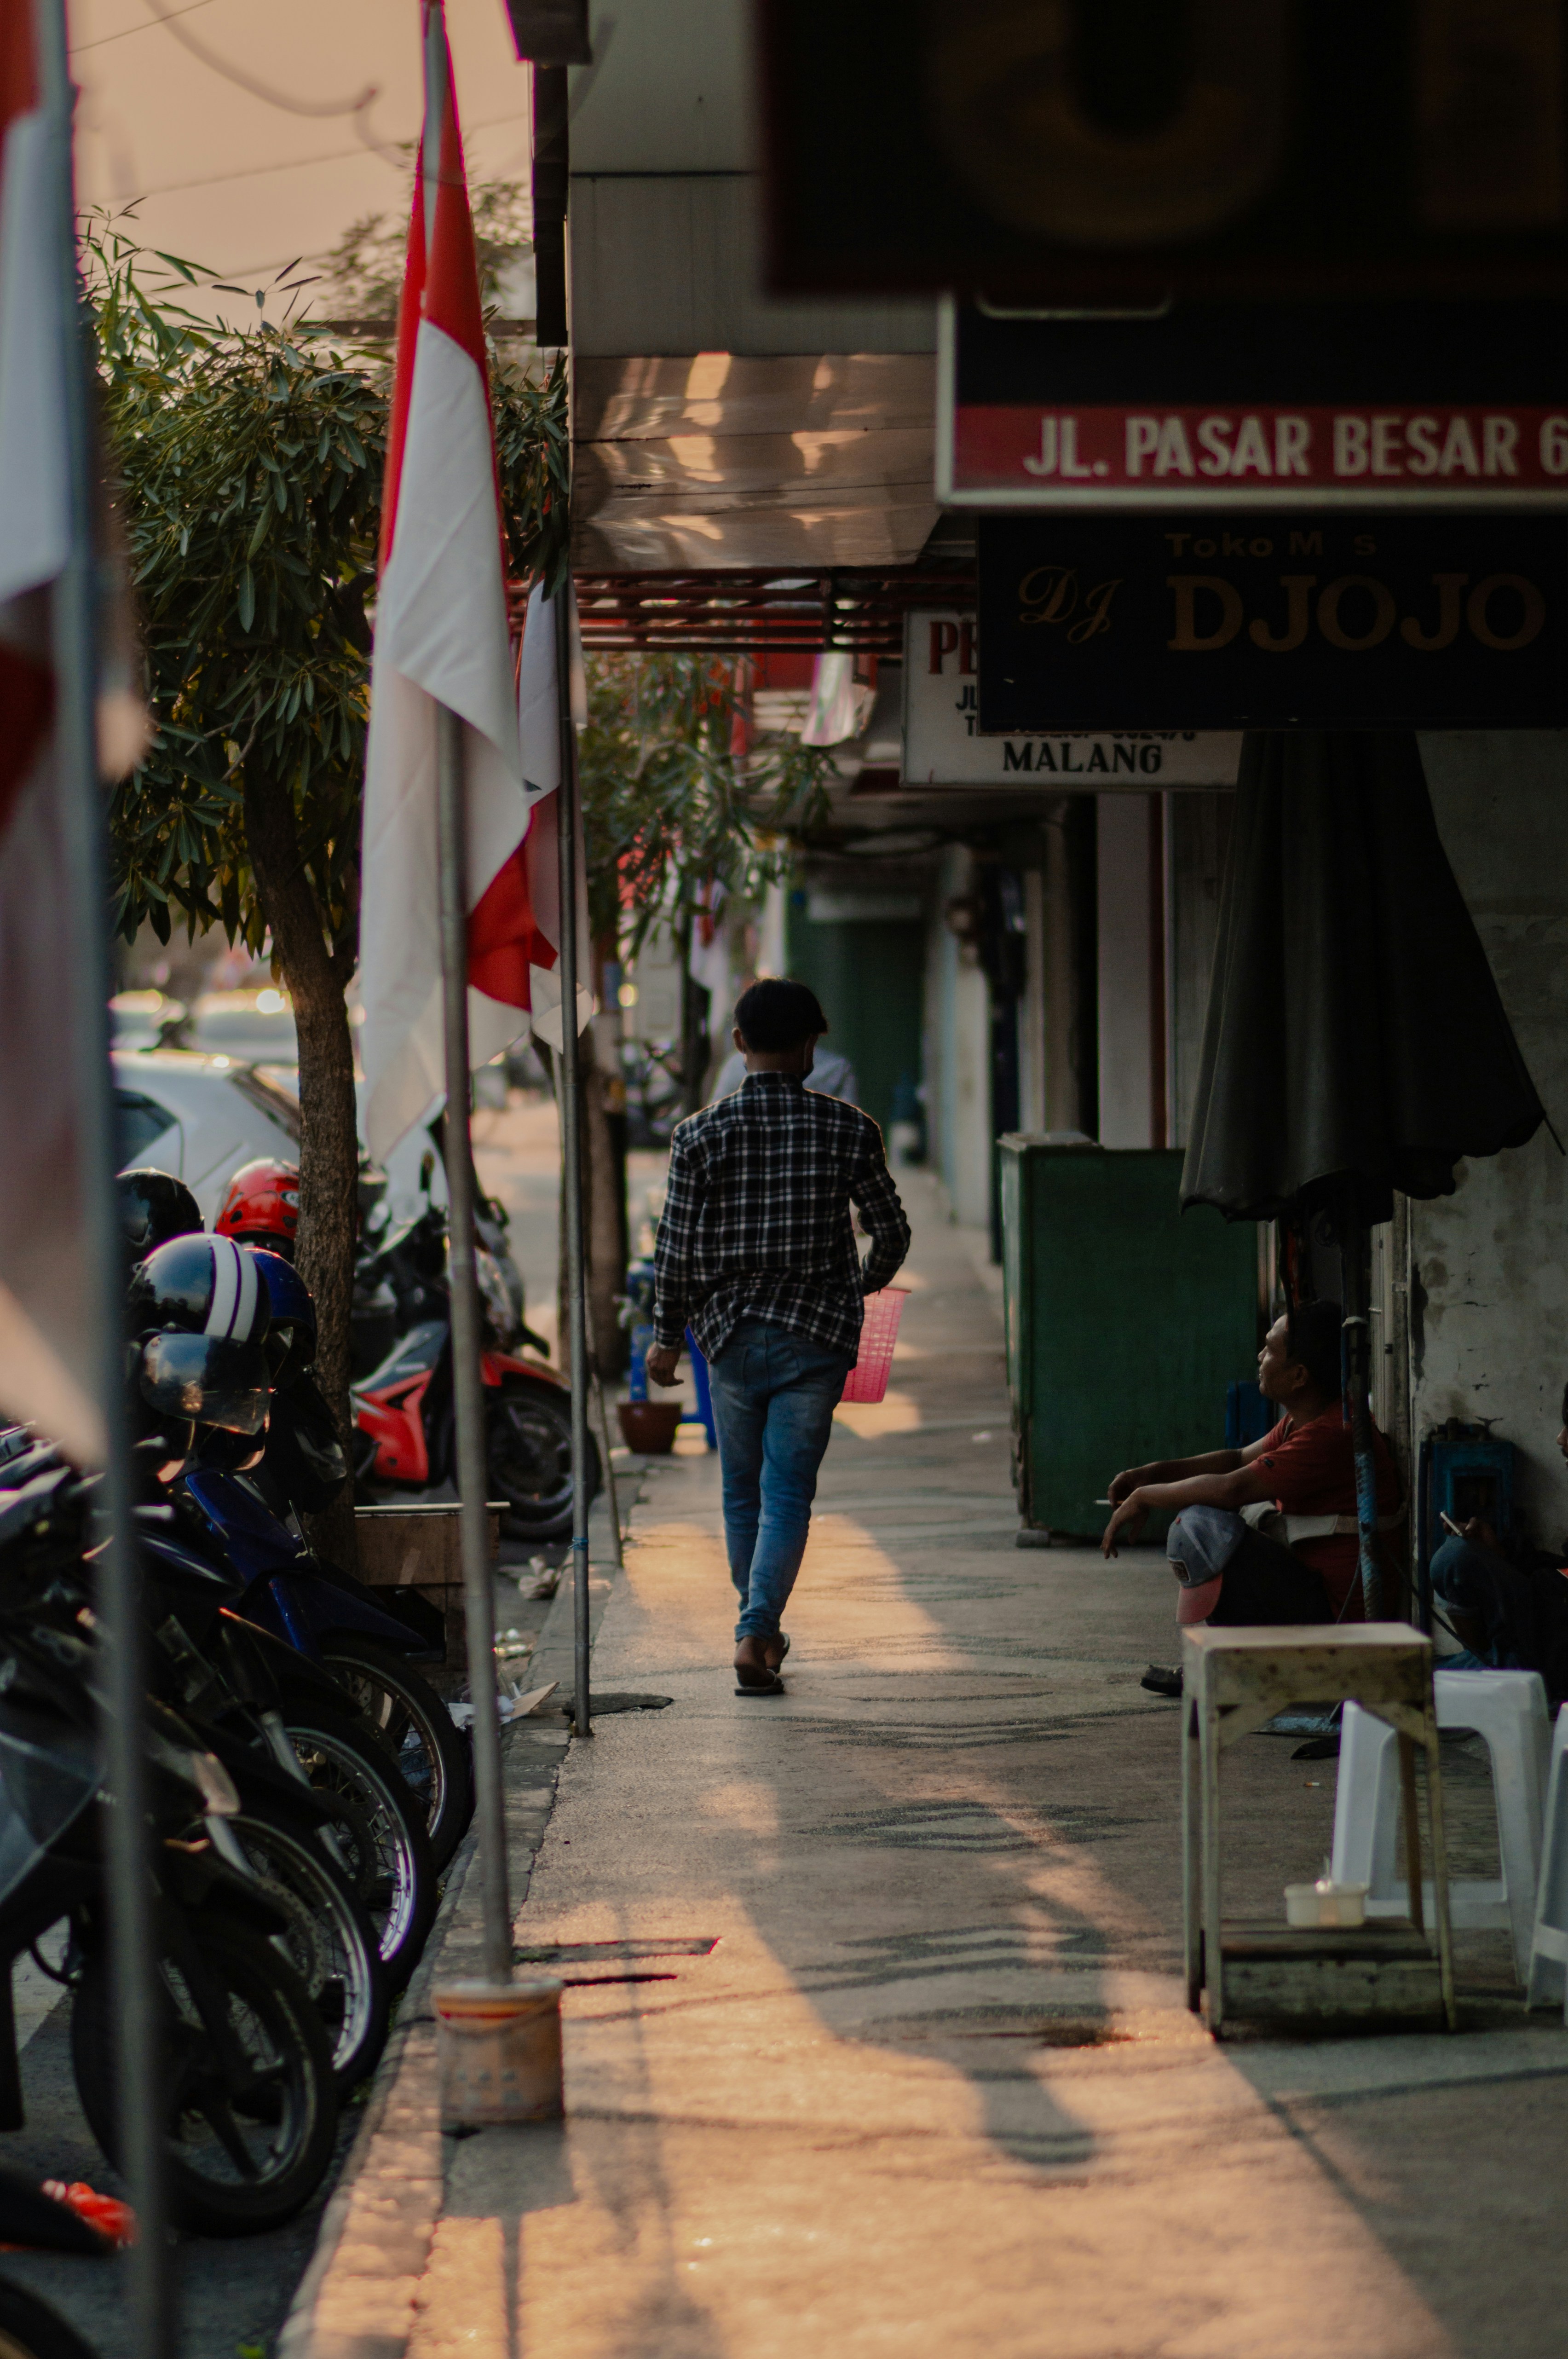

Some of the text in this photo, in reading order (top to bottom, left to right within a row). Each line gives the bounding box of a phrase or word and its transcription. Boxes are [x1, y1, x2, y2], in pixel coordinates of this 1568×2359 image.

[1022, 415, 1110, 477] JL.
[1124, 415, 1312, 477] PASAR
[1333, 415, 1520, 477] BESAR
[1164, 531, 1275, 559] Toko
[1165, 572, 1546, 653] DJOJO
[1003, 741, 1162, 774] MALANG
